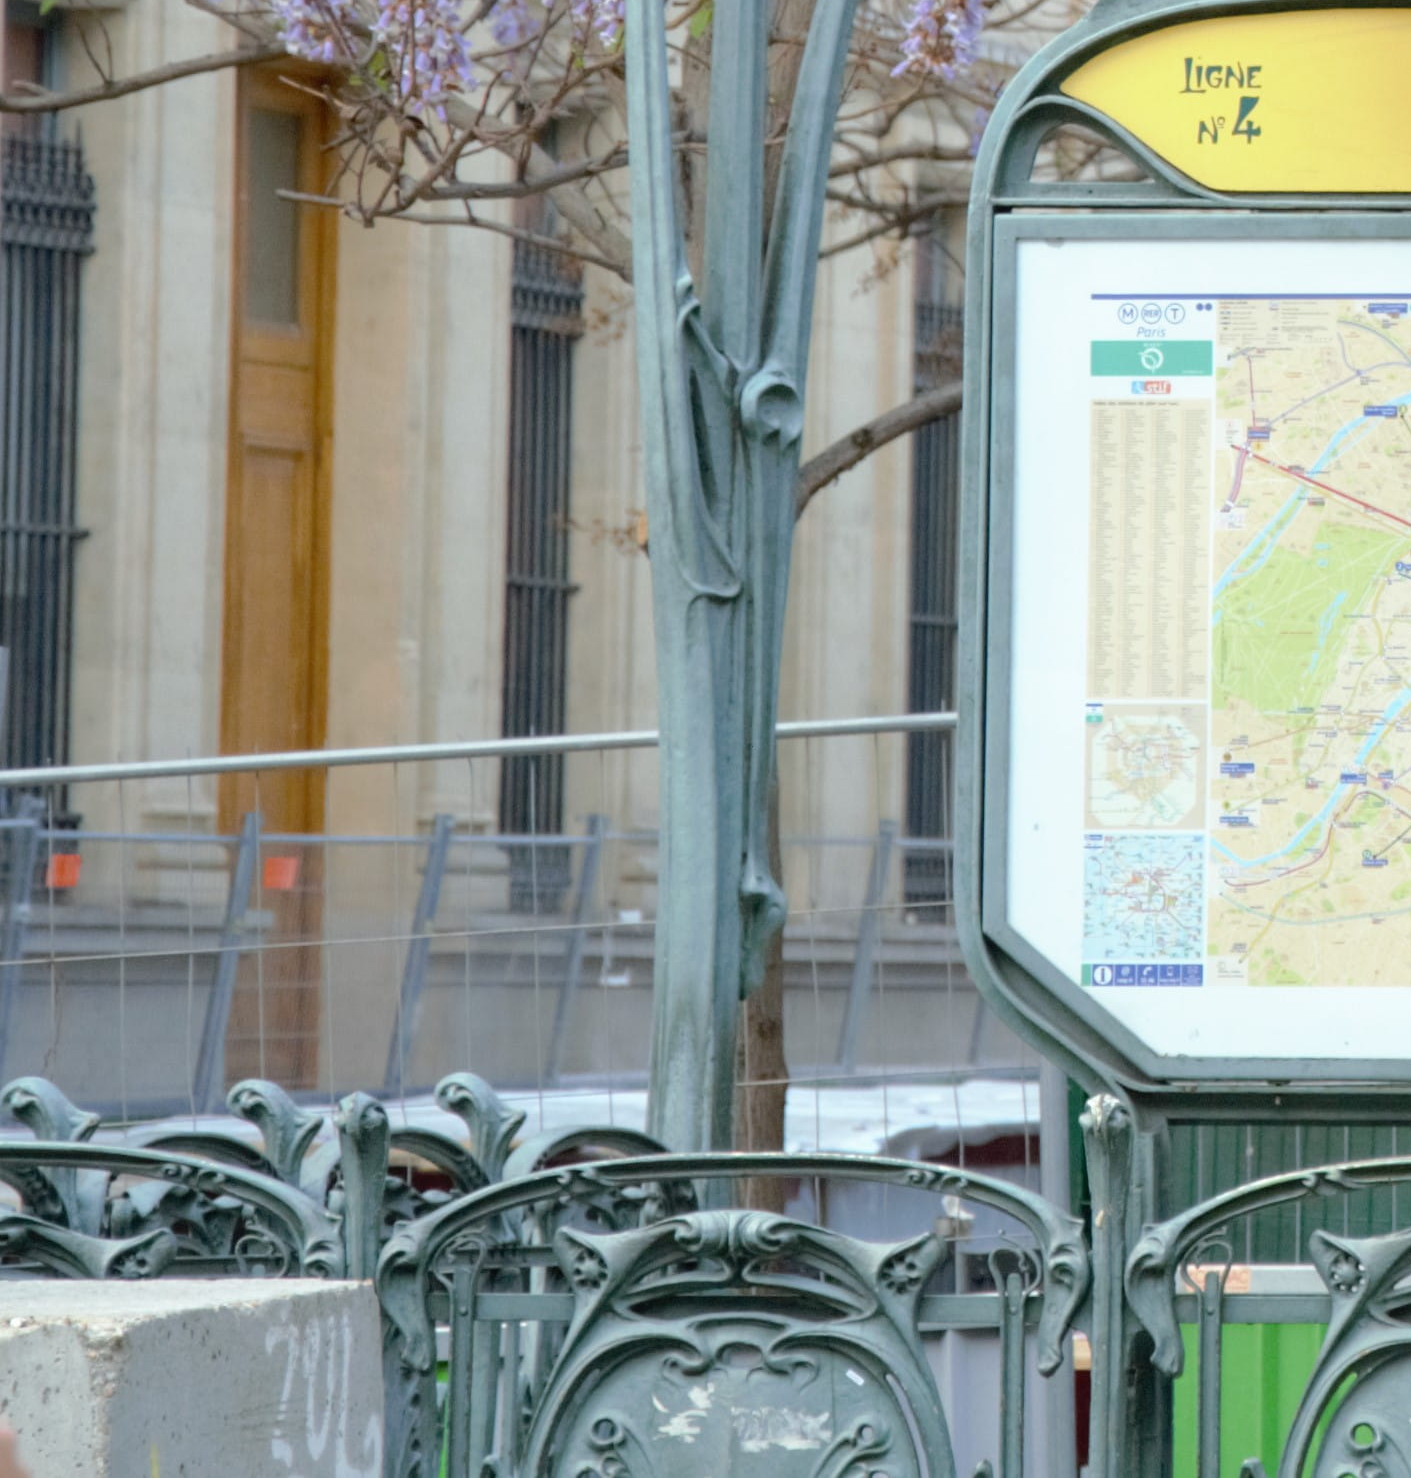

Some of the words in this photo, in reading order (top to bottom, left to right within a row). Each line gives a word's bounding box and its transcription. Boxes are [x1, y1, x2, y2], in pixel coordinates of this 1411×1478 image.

[1179, 56, 1262, 94] LIGNE
[1232, 96, 1261, 144] 4
[1136, 326, 1167, 338] Paris
